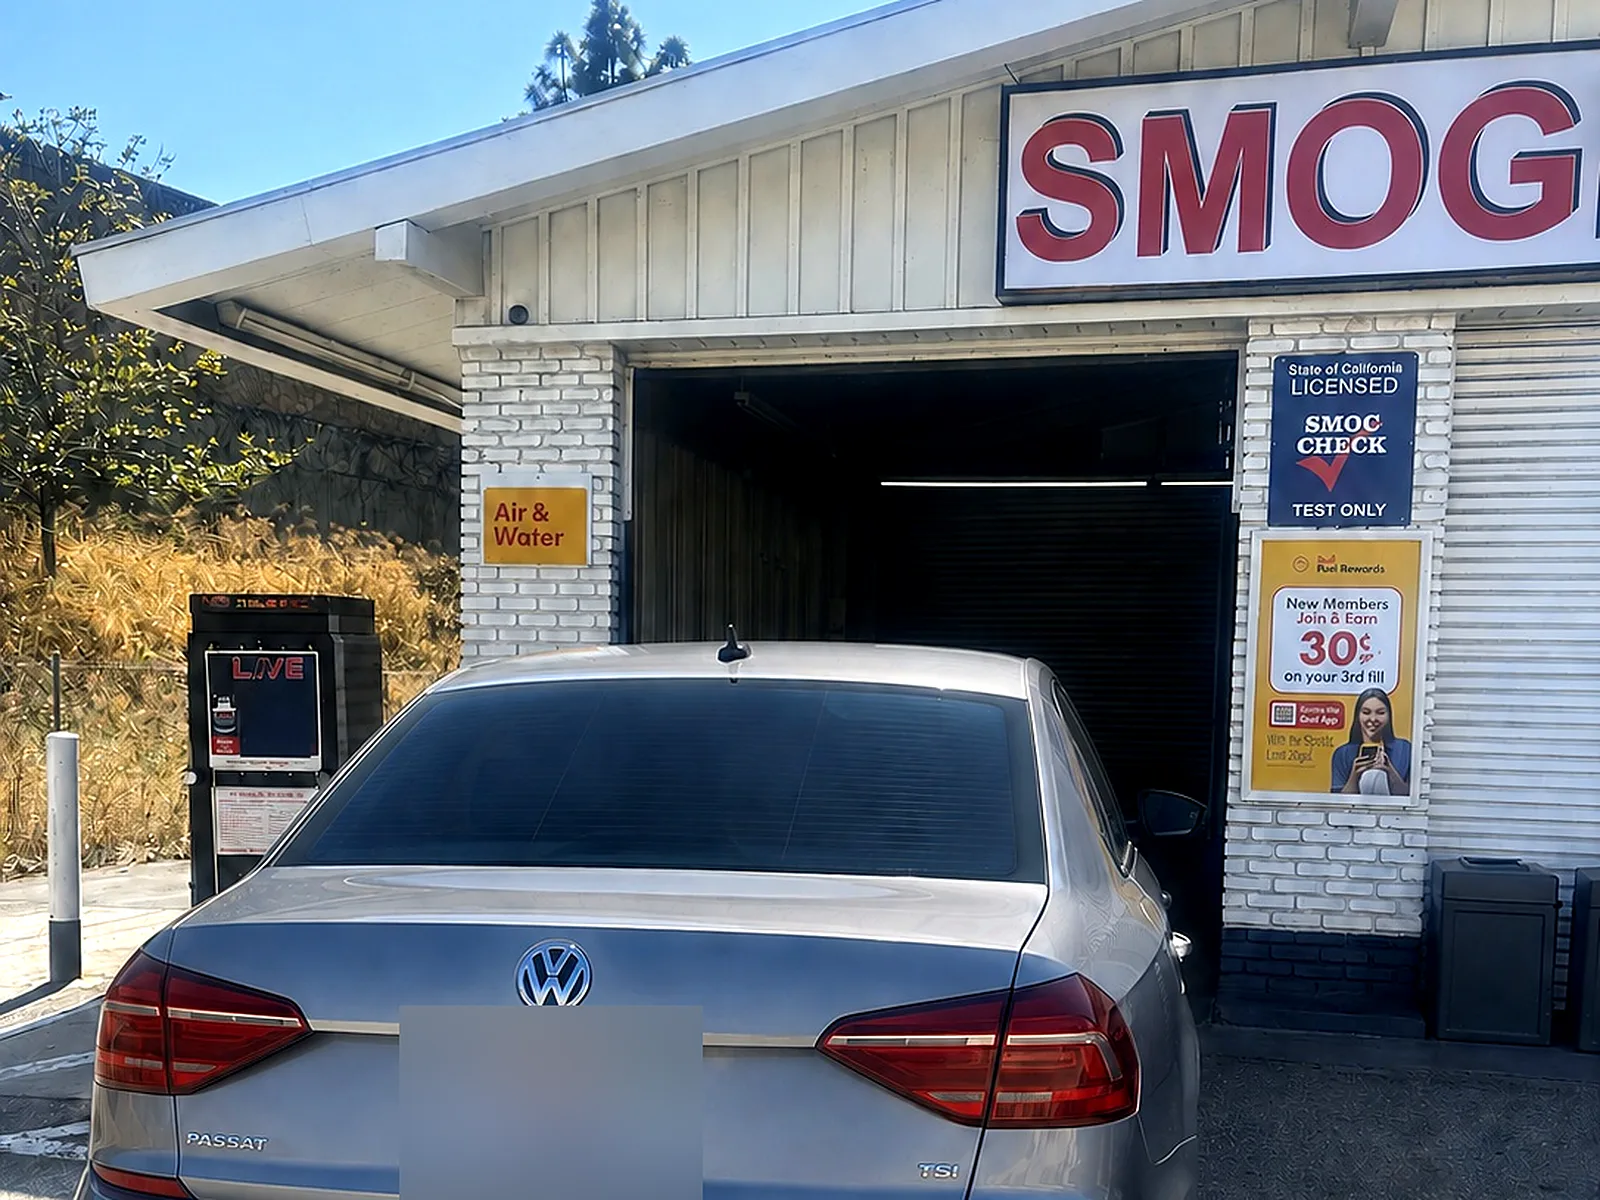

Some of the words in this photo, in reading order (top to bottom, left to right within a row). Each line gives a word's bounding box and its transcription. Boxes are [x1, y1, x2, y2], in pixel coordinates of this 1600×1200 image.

[1016, 80, 1582, 263] SMOG
[1288, 363, 1322, 376] State
[1325, 362, 1338, 375] of
[1341, 361, 1402, 375] California
[1291, 377, 1398, 395] LICENSED
[1297, 436, 1387, 455] CHECK
[494, 502, 527, 522] Air
[532, 502, 549, 522] &
[1292, 503, 1336, 517] TEST
[1340, 503, 1387, 517] ONLY
[494, 526, 564, 546] Water
[1340, 563, 1386, 574] Rewards
[1286, 597, 1319, 610] New
[1323, 597, 1389, 610] Members
[1297, 612, 1326, 624] Join
[1345, 612, 1378, 624] Earn
[1284, 671, 1301, 682] on
[1305, 672, 1338, 685] your
[1341, 670, 1364, 683] 3rd
[1368, 670, 1385, 684] fill
[186, 1132, 268, 1151] PASSAT
[918, 1163, 959, 1179] TSI
